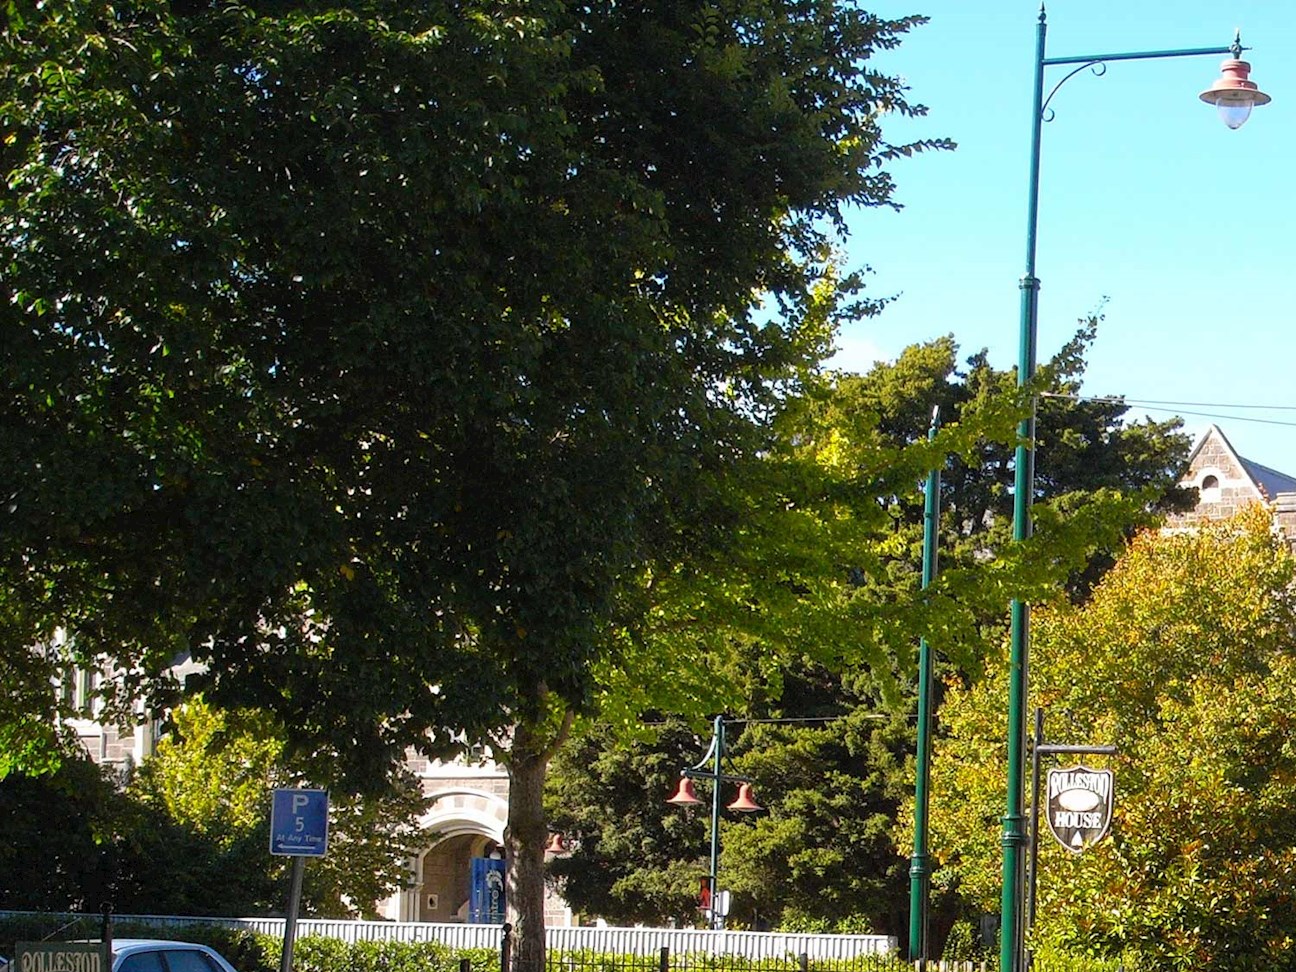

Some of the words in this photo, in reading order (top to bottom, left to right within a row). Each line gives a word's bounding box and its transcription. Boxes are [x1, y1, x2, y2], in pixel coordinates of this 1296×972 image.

[292, 794, 310, 815] P
[295, 816, 305, 832] 5
[1055, 811, 1102, 829] HOUSE
